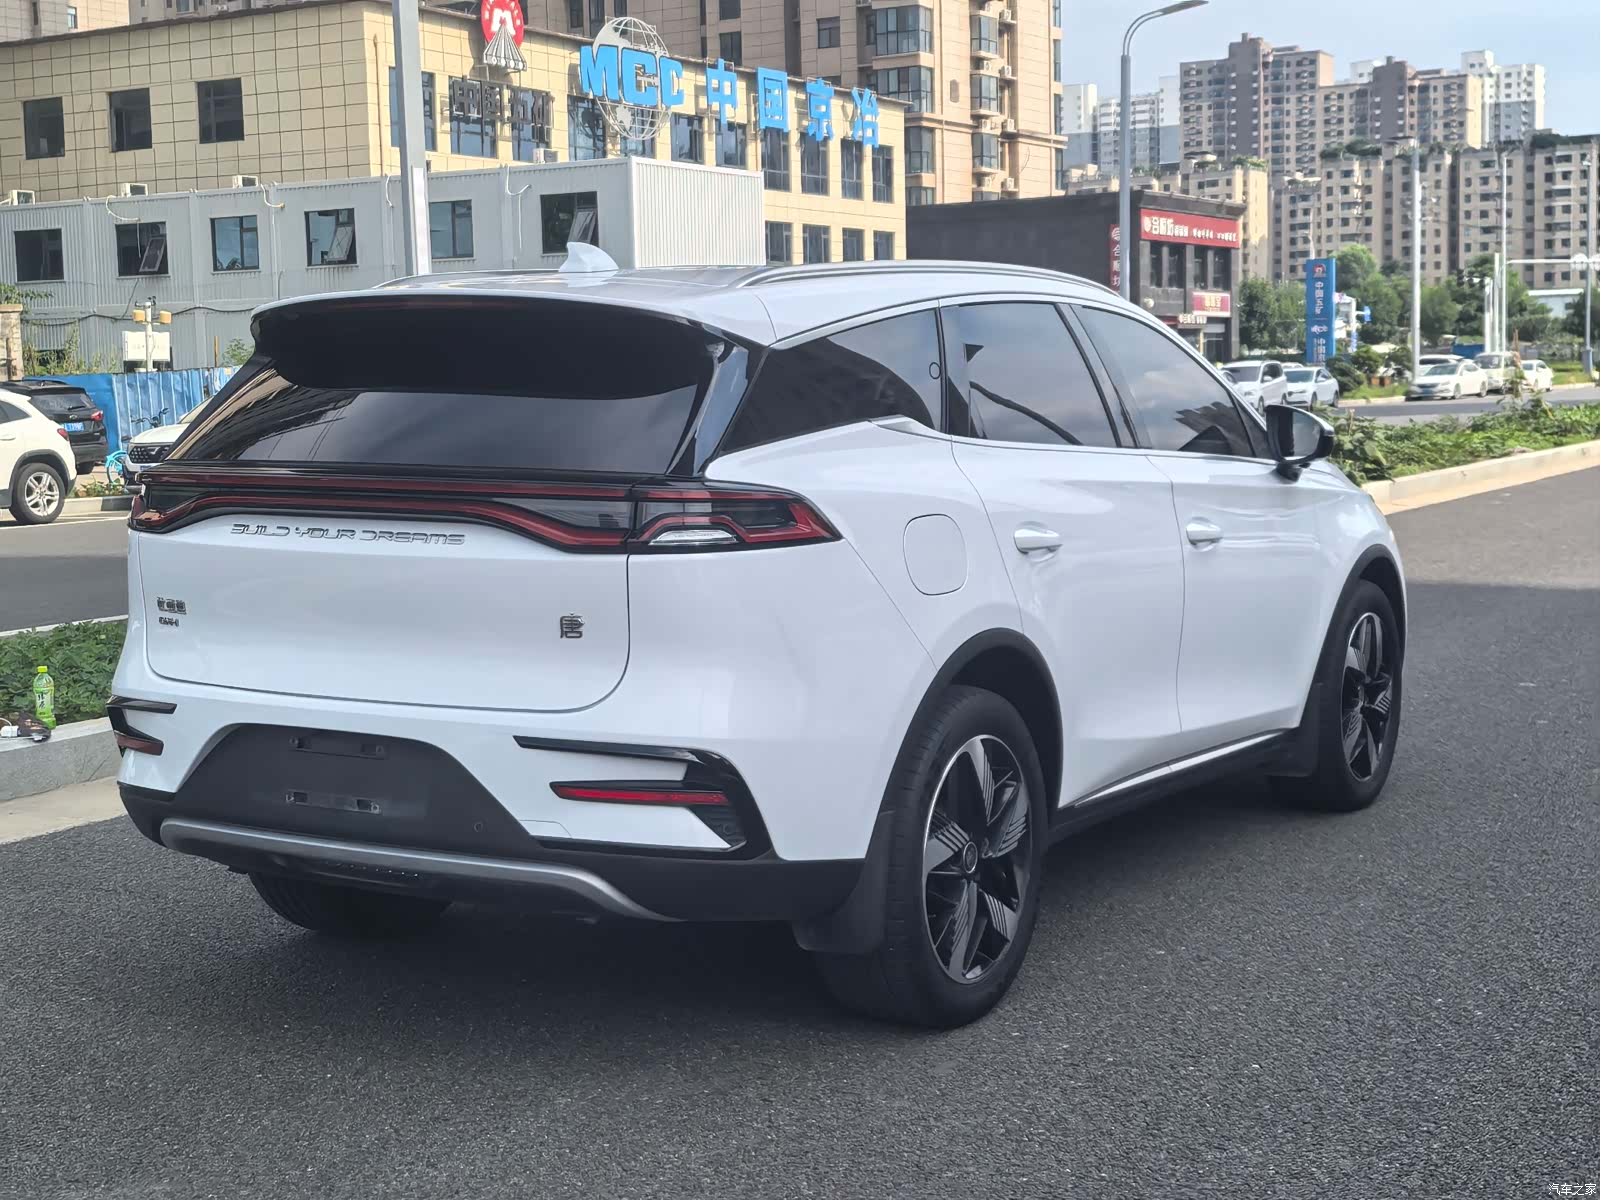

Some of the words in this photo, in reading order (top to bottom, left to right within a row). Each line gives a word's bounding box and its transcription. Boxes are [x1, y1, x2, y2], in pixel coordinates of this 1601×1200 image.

[580, 43, 685, 107] MCC
[706, 58, 880, 148] 中国京冶
[231, 523, 290, 537] BUILD
[295, 526, 356, 540] YOUR
[359, 530, 466, 545] DREAMS
[559, 613, 585, 639] 唐
